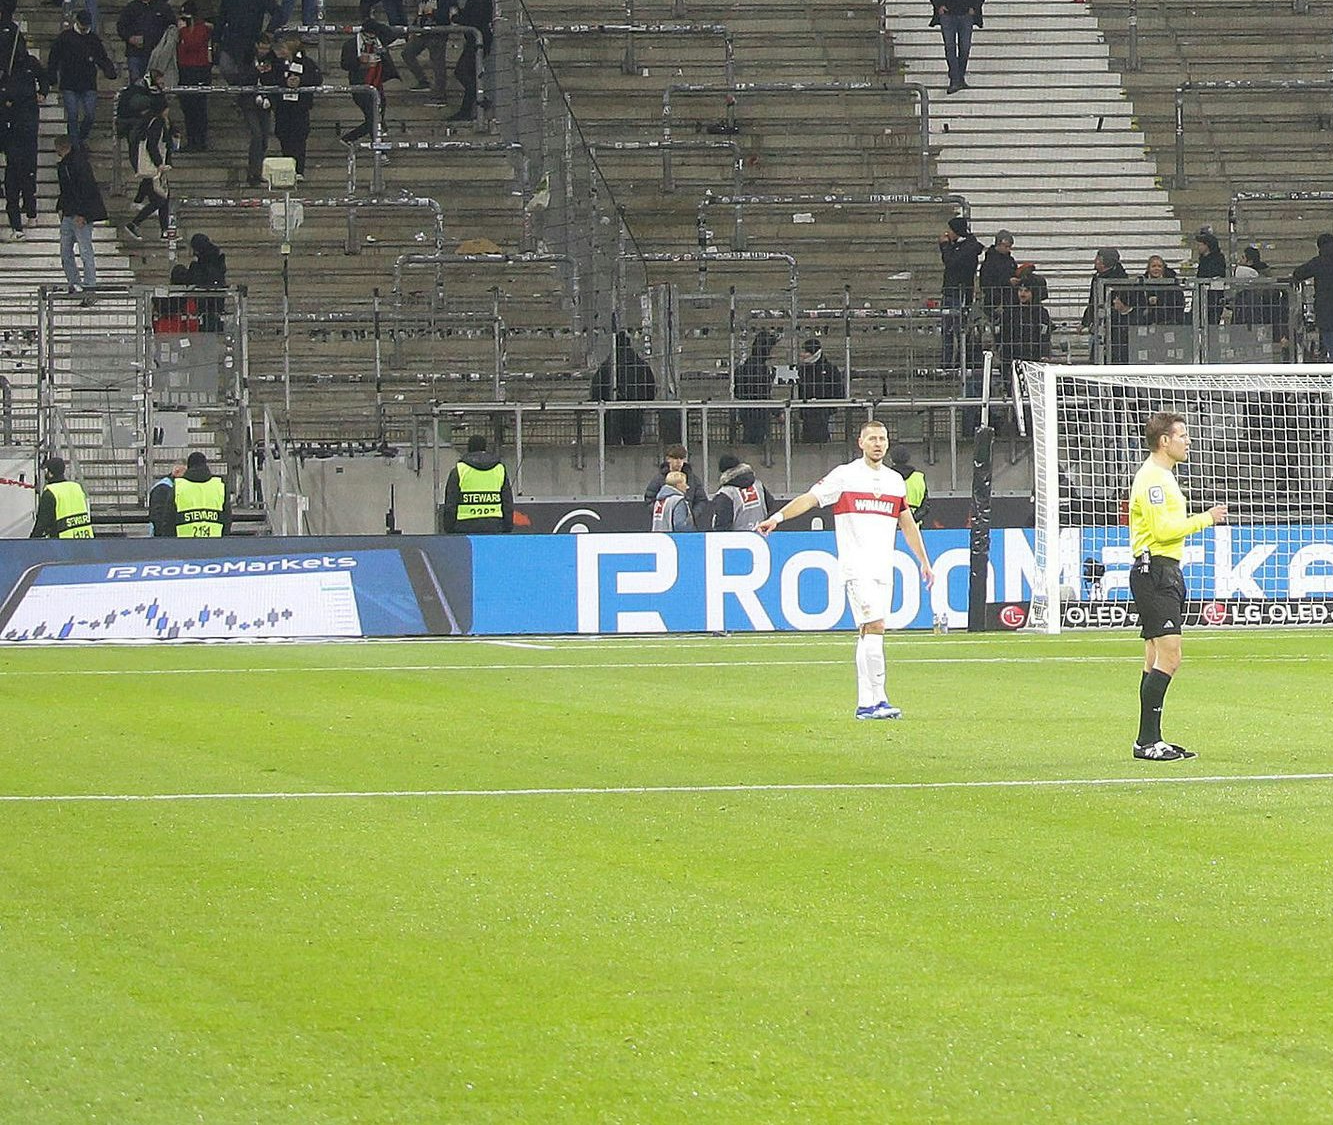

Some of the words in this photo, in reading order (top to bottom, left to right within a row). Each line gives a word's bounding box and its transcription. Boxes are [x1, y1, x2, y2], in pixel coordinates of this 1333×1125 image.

[141, 556, 357, 578] RoboMarkets
[1231, 605, 1261, 622] LG
[1269, 603, 1328, 621] OLED
